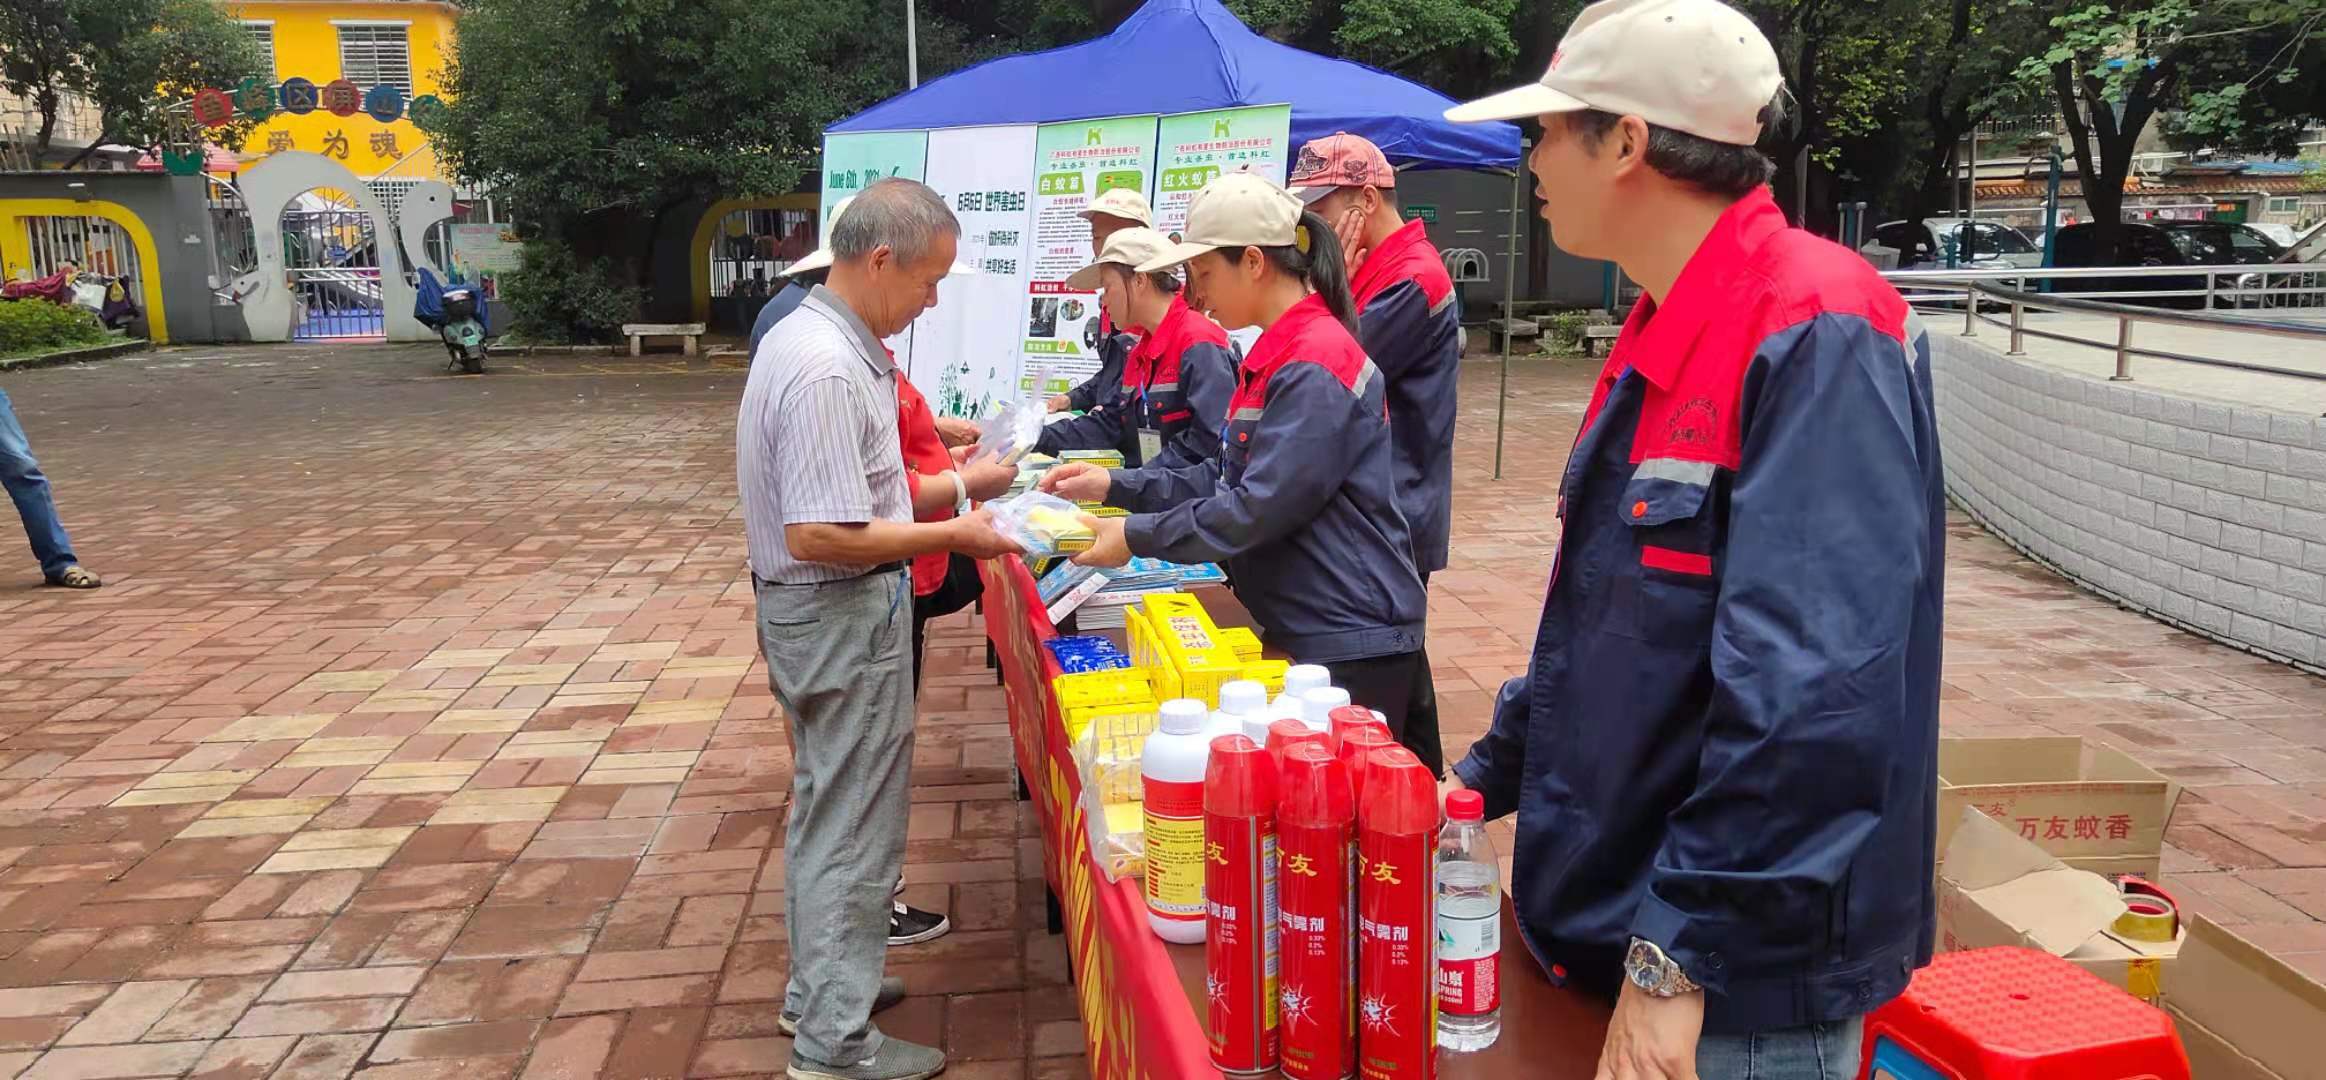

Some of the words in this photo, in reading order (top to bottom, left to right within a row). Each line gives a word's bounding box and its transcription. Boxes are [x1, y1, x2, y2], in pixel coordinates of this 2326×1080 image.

[267, 128, 404, 160] 爱为魂
[828, 169, 845, 188] June
[1041, 176, 1080, 191] 白蚁篇
[957, 192, 983, 212] 6月6日
[985, 190, 1026, 212] 世界害虫日
[985, 258, 1017, 275] 共享好生活
[2015, 814, 2133, 841] 万友蚊香
[1207, 841, 1228, 865] 友
[1208, 900, 1236, 921] 雾剂
[1279, 908, 1325, 932] 气雾剂
[1439, 985, 1463, 998] PRING
